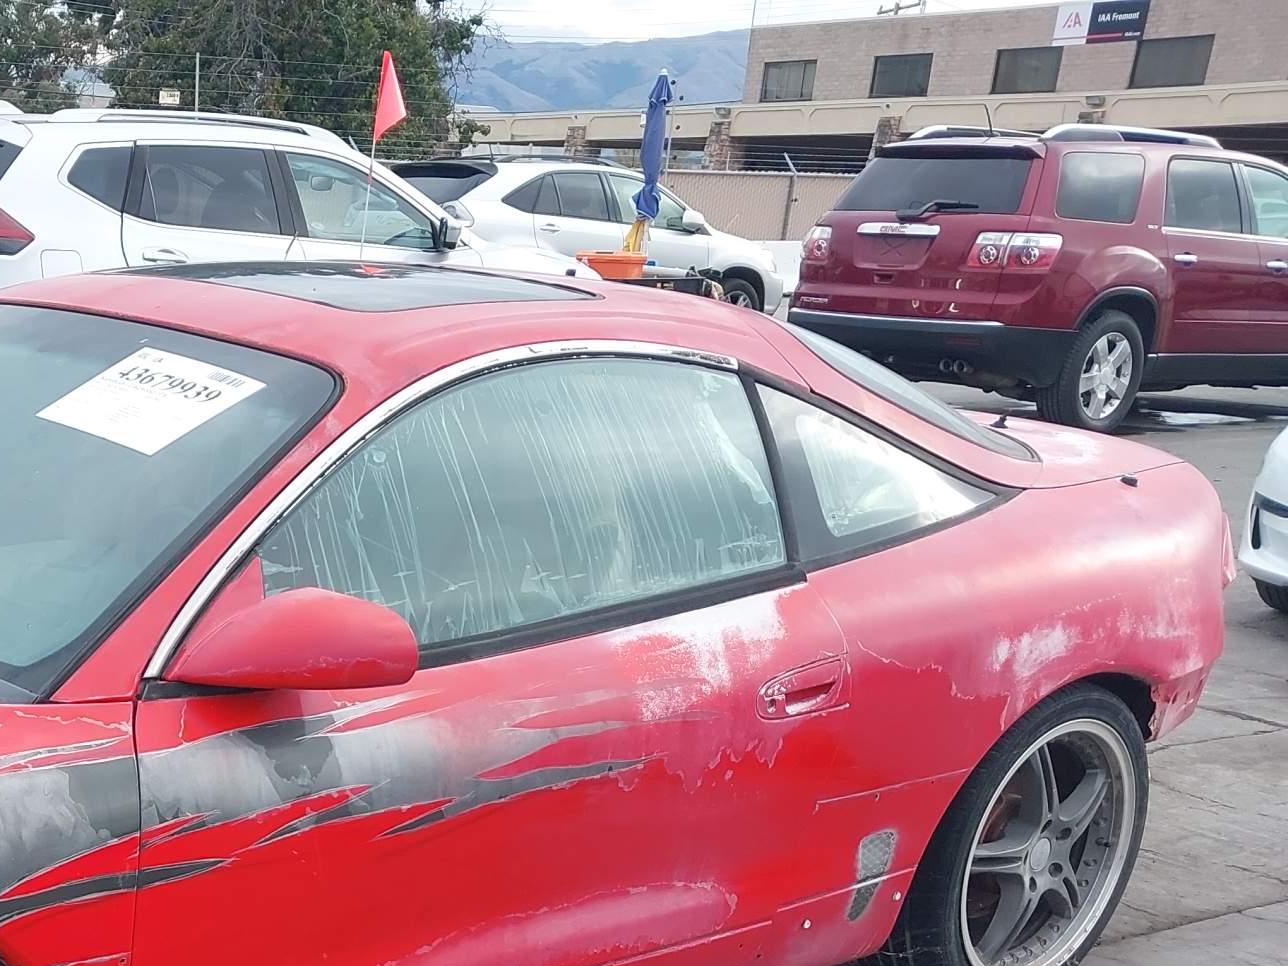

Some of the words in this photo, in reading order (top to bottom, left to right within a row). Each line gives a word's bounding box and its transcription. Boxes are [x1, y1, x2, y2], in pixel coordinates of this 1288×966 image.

[1098, 13, 1111, 23] IAA
[1112, 11, 1141, 21] Fremont
[879, 225, 908, 233] GMC
[118, 365, 223, 403] 43679939
